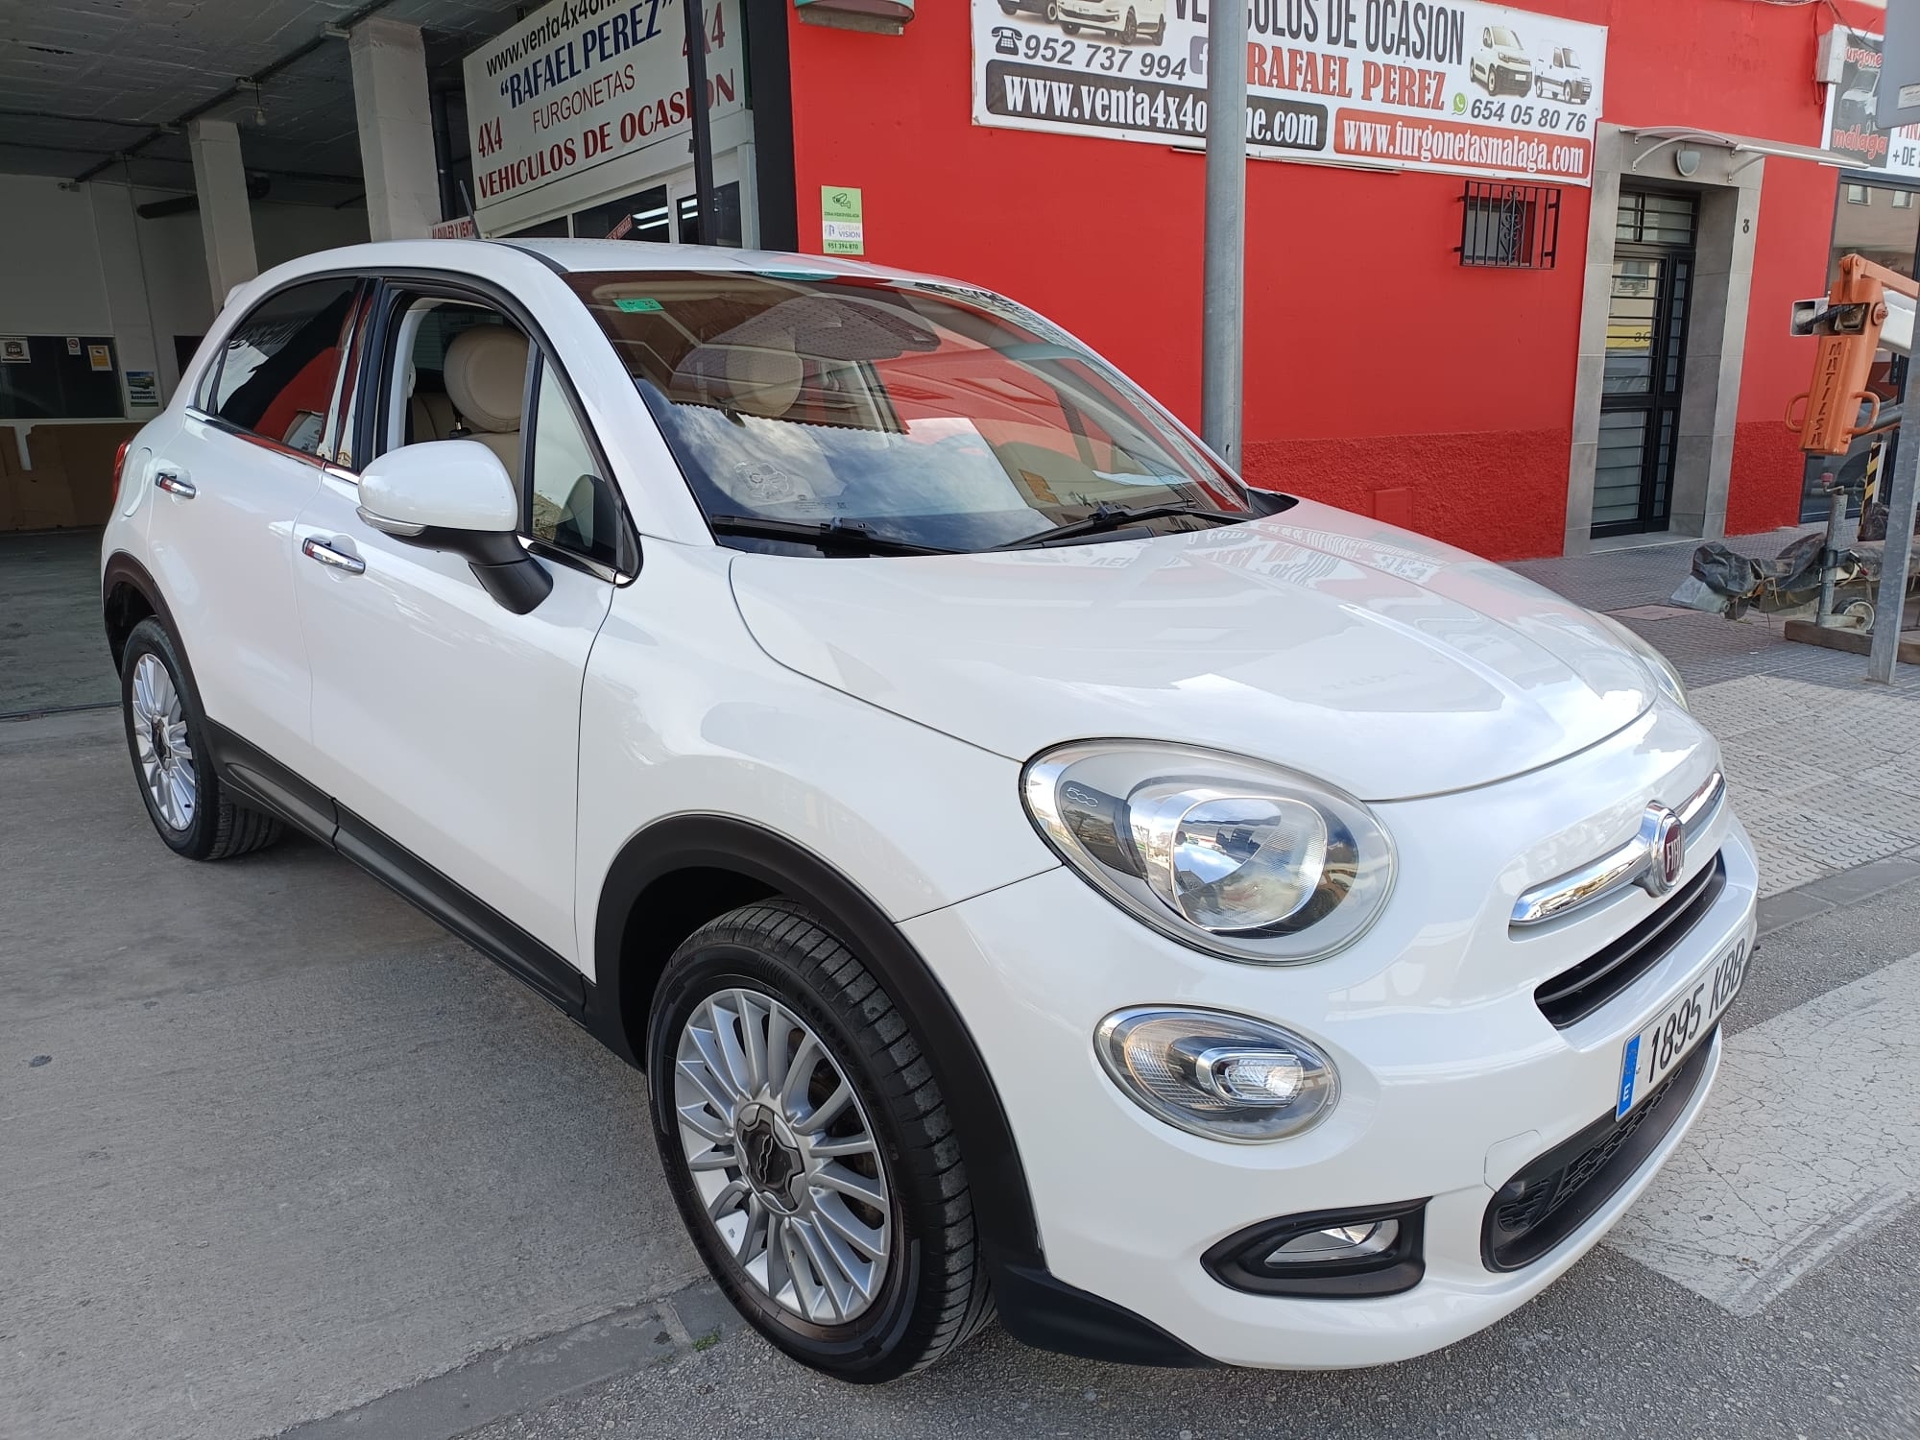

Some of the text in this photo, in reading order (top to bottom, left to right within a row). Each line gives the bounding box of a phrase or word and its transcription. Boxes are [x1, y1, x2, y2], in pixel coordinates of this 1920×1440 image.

[1327, 0, 1358, 49] DE
[1366, 0, 1465, 65] OCASION
[1023, 34, 1187, 81] 952 737 994
[1247, 42, 1447, 110] RAFAEL PEREZ
[533, 64, 635, 134] FURGONETAS
[1471, 99, 1587, 132] 654 05 80 76
[478, 116, 503, 158] 4X4
[478, 138, 577, 199] VEHICULOS
[583, 121, 613, 159] DE
[1343, 119, 1585, 174] www.furgonetasmalaga.com
[1902, 146, 1917, 167] DE
[838, 231, 861, 239] VISION
[1742, 218, 1750, 234] 3
[1649, 938, 1745, 1083] 1895 KBB
[1622, 1082, 1631, 1101] E
